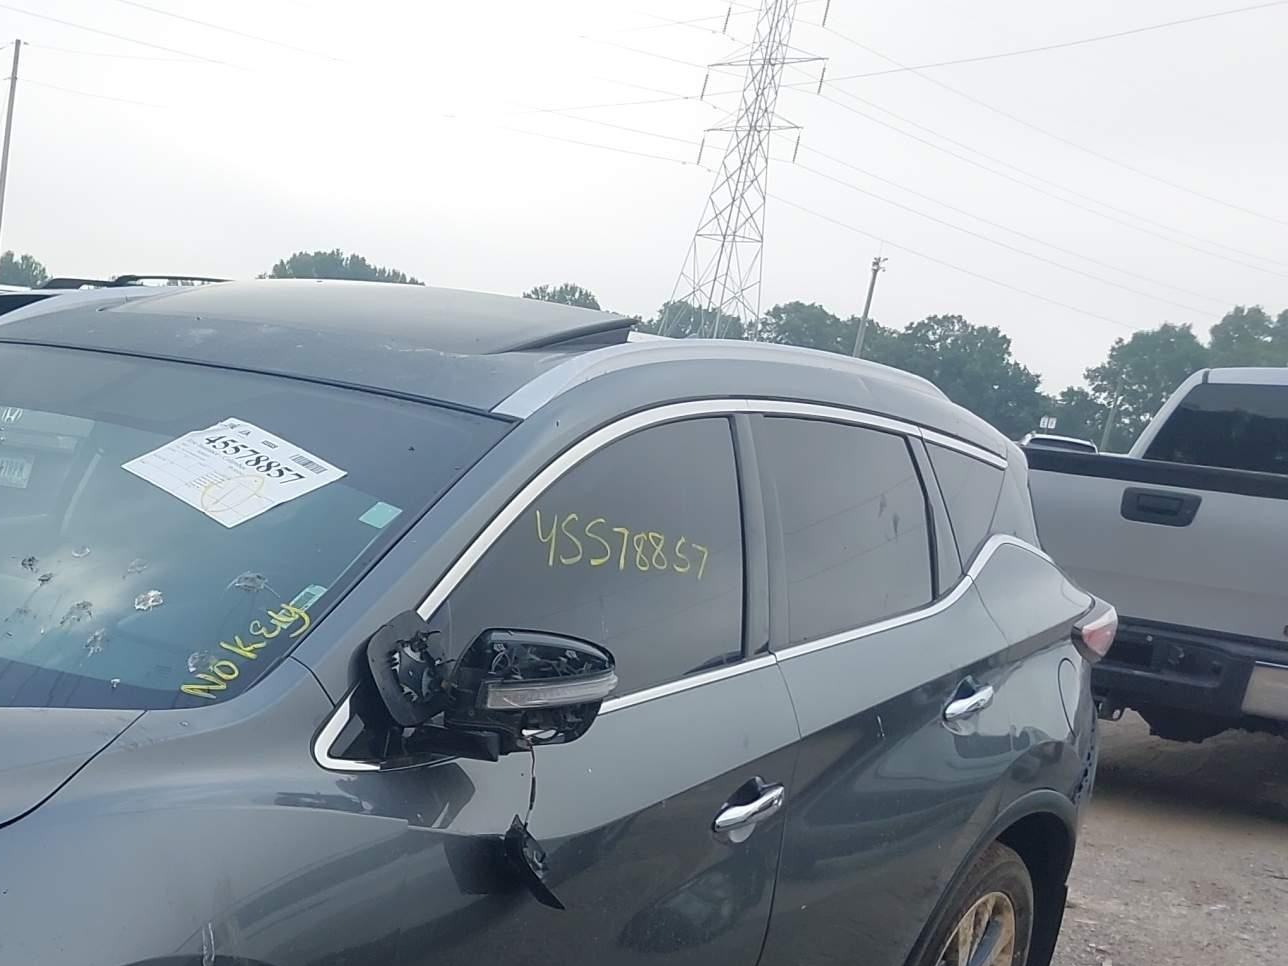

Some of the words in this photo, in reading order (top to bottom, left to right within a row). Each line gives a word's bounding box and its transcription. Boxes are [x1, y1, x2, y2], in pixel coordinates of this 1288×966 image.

[205, 435, 306, 484] 45578857
[535, 510, 709, 580] 45578857
[180, 660, 240, 699] NO
